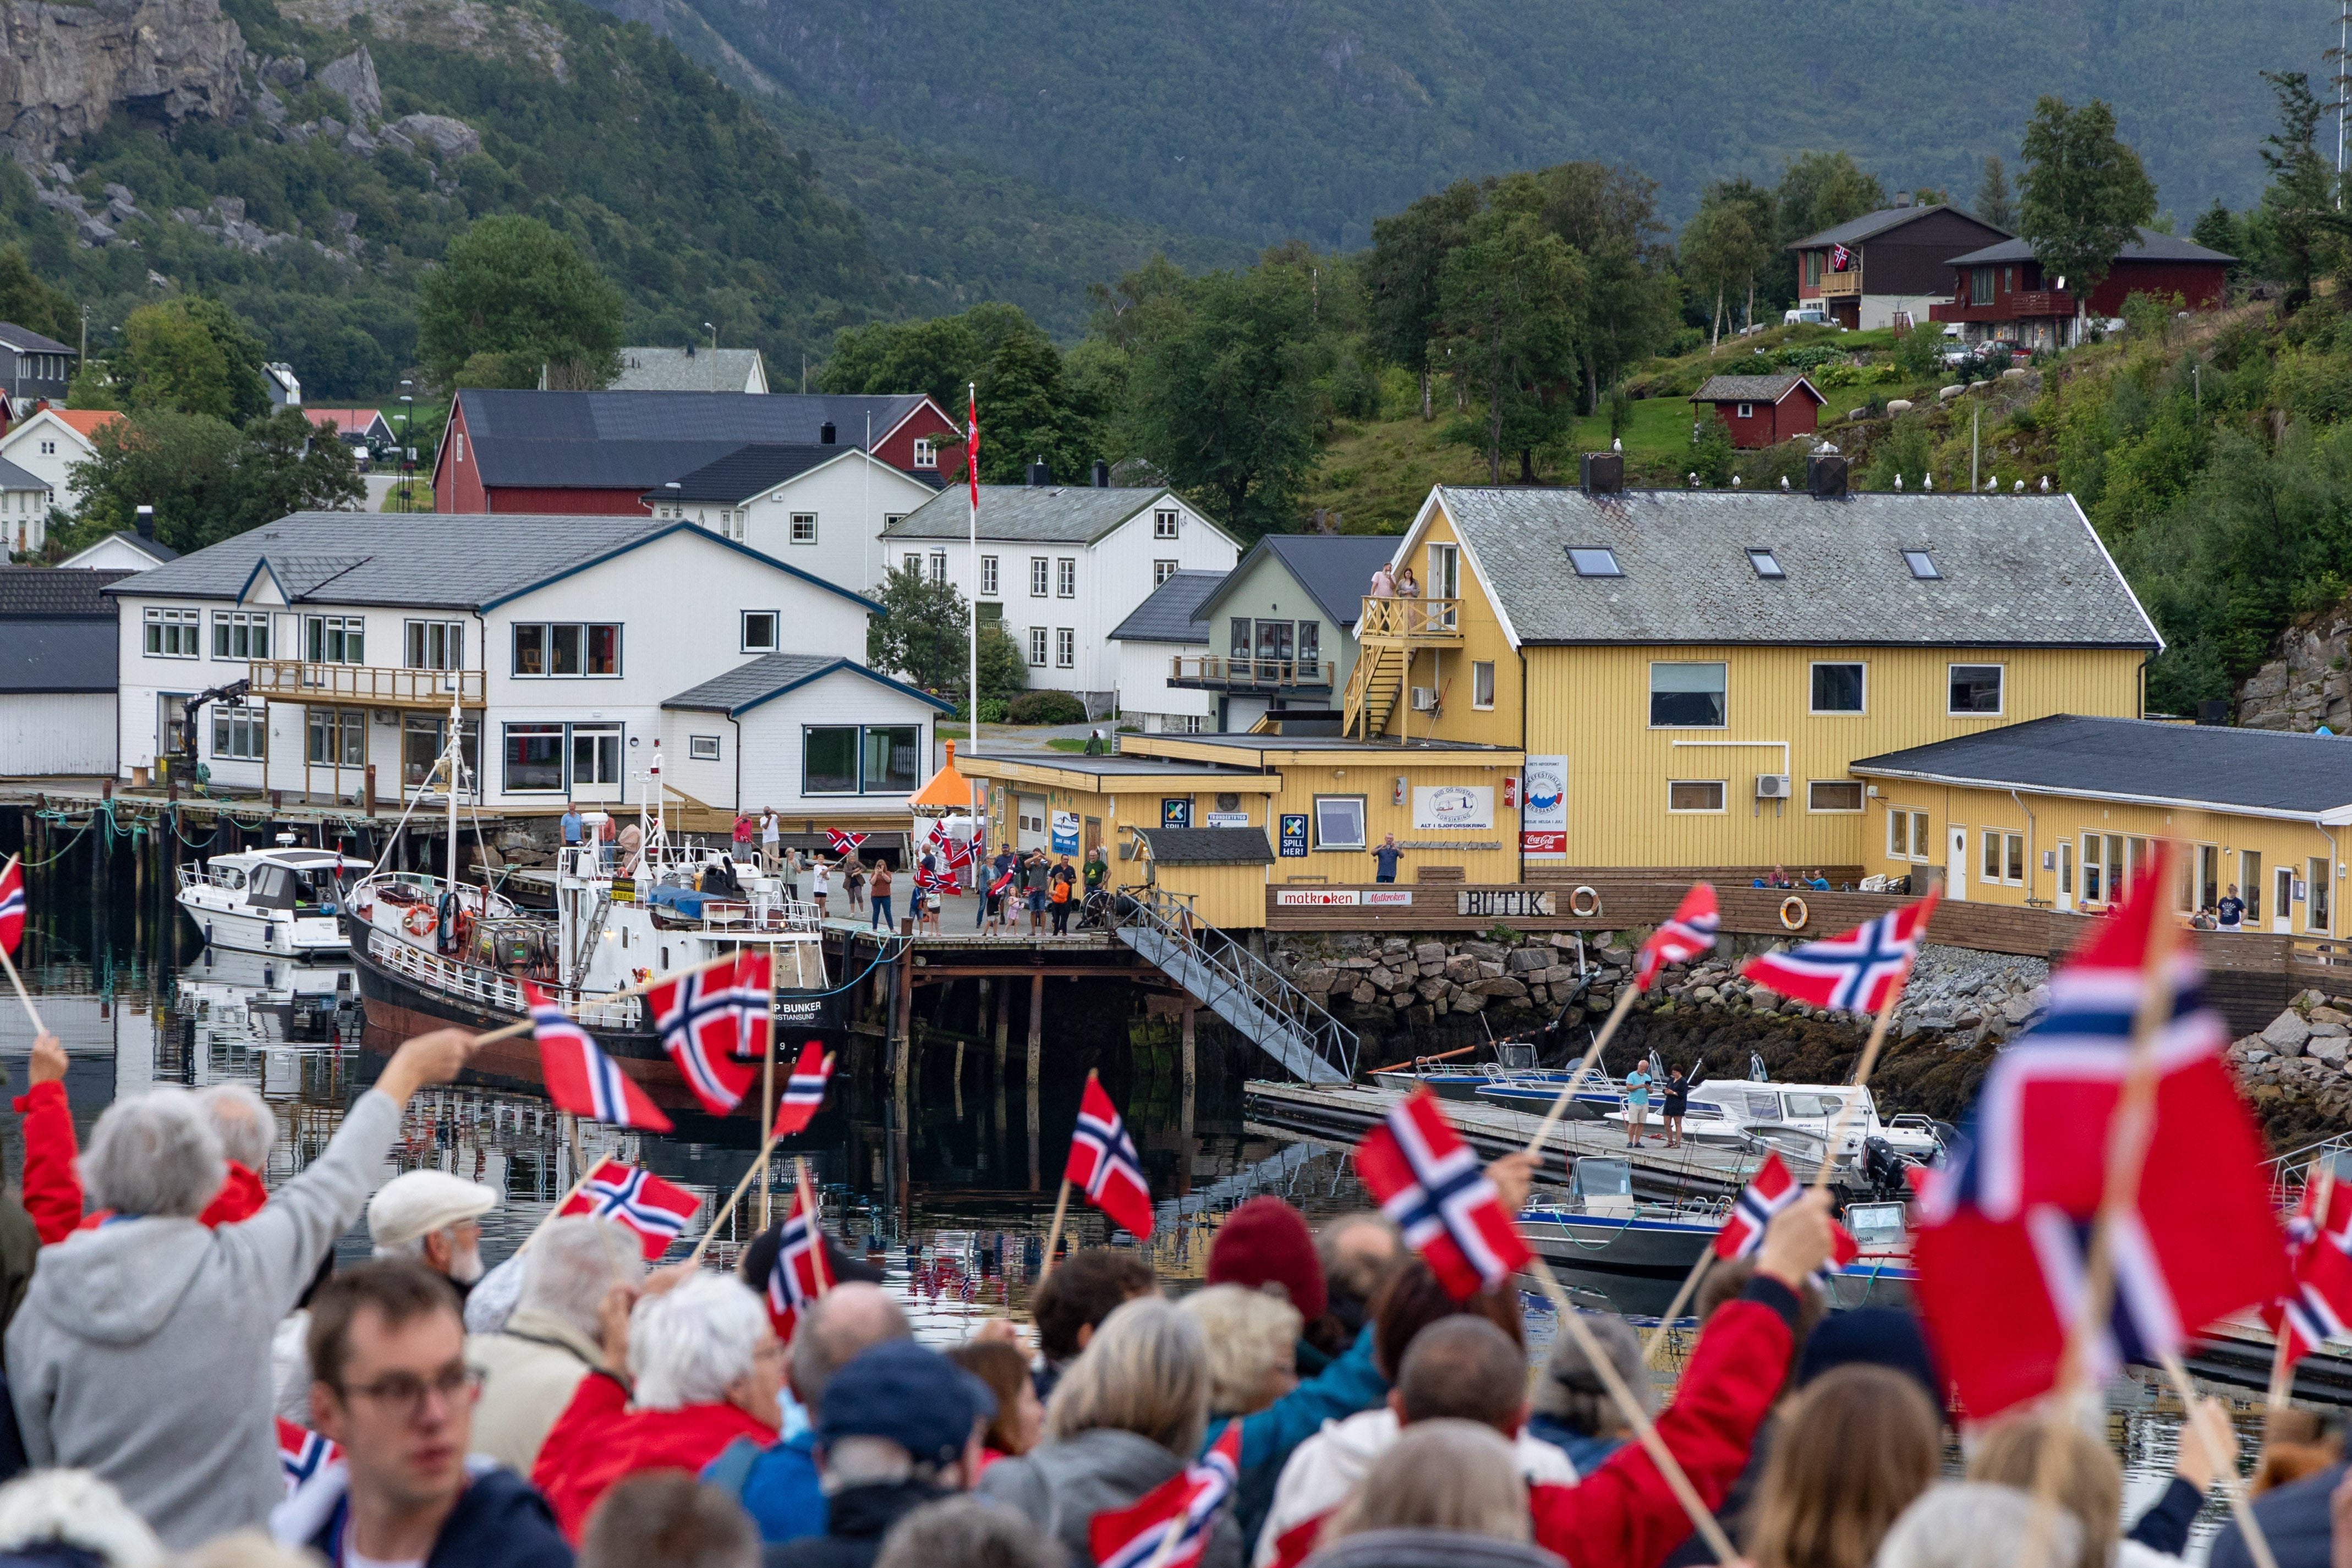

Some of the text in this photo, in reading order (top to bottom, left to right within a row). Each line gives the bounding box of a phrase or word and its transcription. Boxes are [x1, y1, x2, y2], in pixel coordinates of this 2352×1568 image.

[1434, 790, 1444, 798] BUD
[1455, 788, 1474, 798] HUSTAD
[1437, 813, 1471, 822] FORSIKRING
[1368, 892, 1406, 903] Matkroken
[783, 1001, 821, 1013] BUNKER
[780, 1042, 785, 1050] 9
